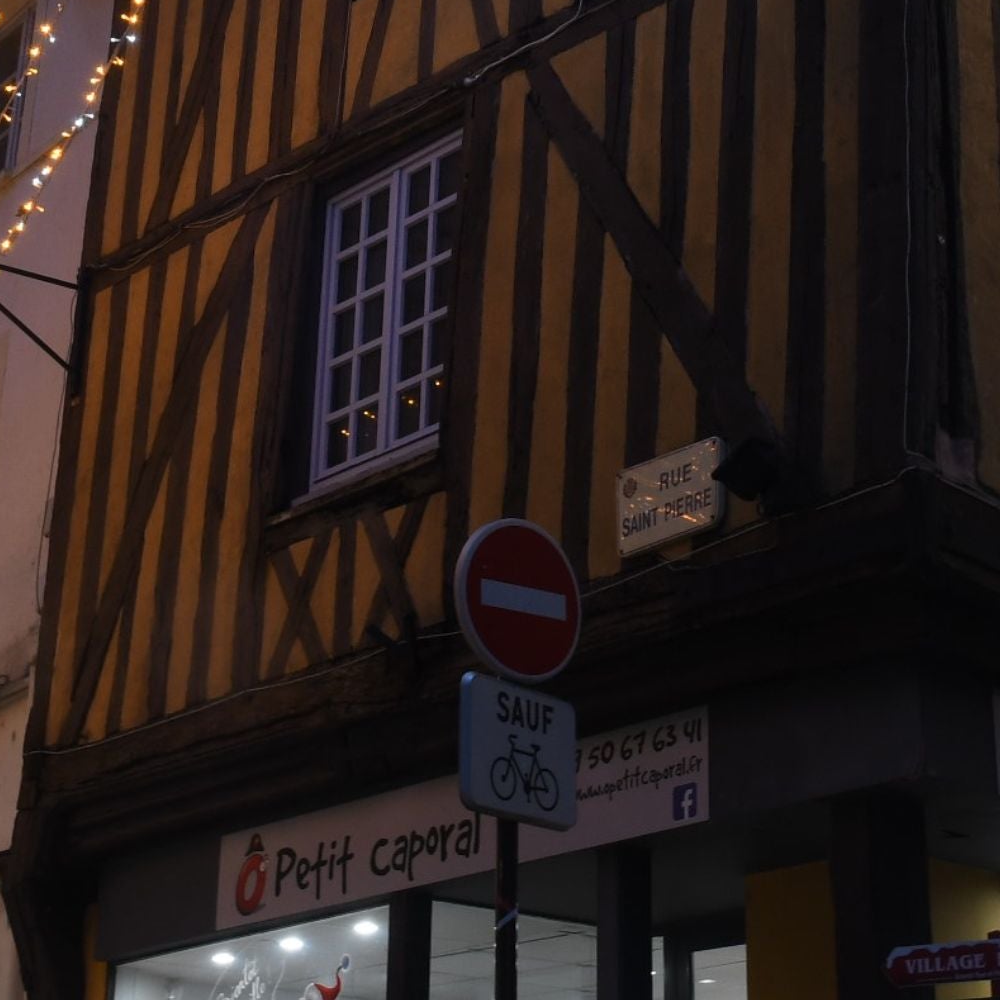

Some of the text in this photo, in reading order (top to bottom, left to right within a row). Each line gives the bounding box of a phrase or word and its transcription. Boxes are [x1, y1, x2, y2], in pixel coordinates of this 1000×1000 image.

[659, 463, 692, 491] RUE
[622, 488, 711, 537] SAINT PIERRE
[496, 691, 554, 735] SAUF
[589, 741, 614, 769] 50
[621, 730, 647, 760] 67
[652, 724, 677, 752] 63
[683, 718, 702, 743] 41
[275, 835, 354, 899] Petit
[370, 811, 480, 881] caporal
[905, 953, 985, 974] VILLAGE
